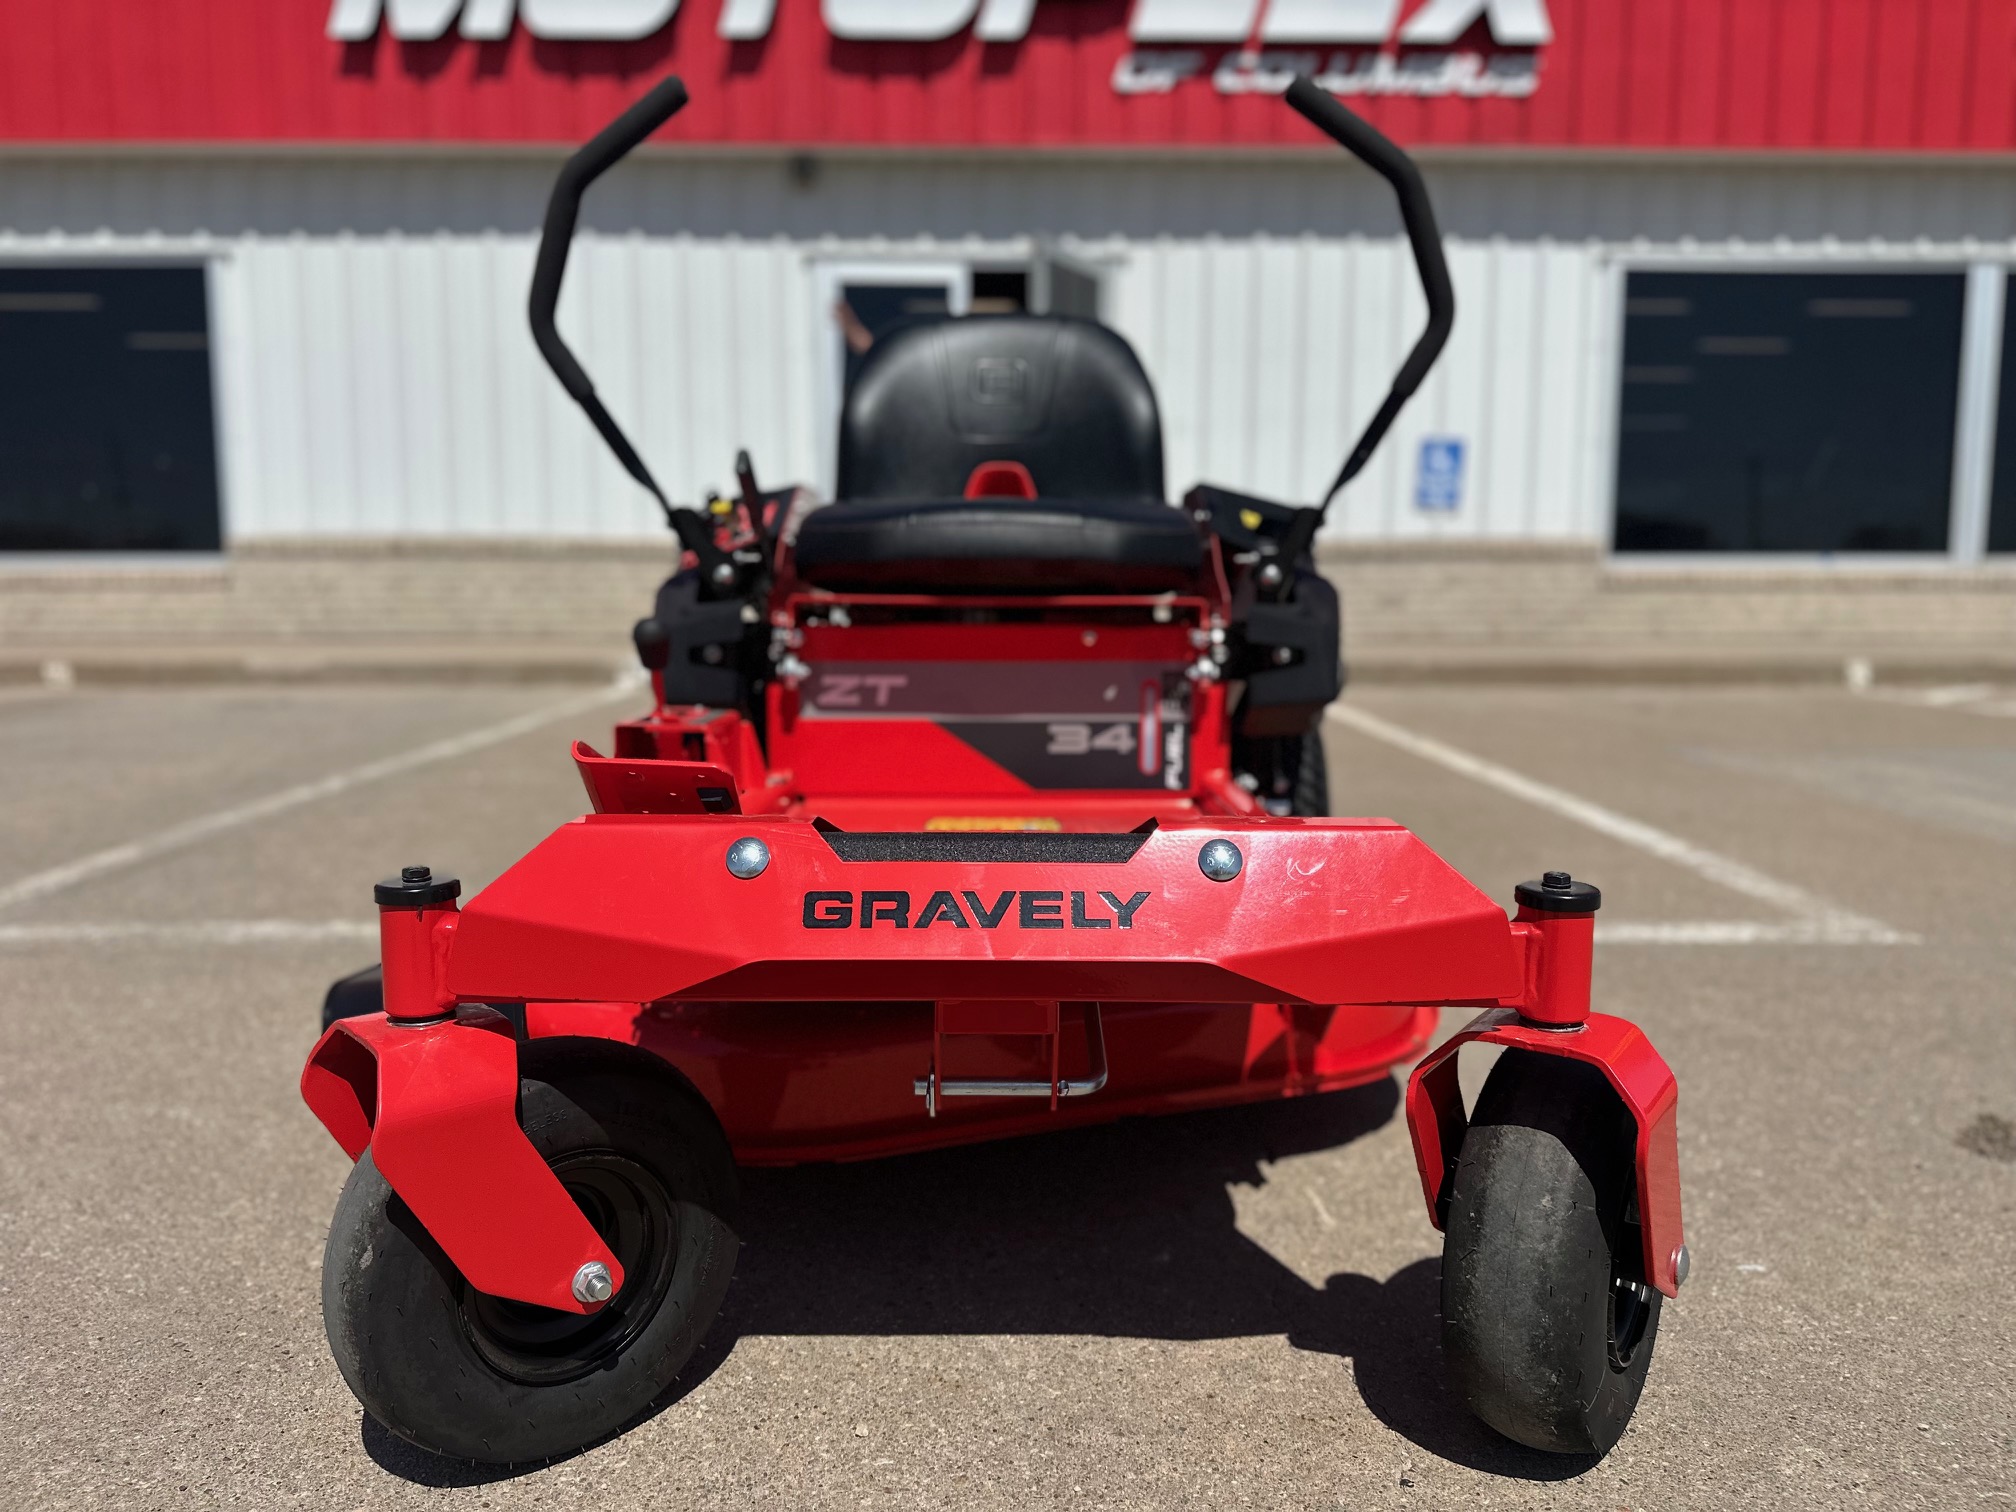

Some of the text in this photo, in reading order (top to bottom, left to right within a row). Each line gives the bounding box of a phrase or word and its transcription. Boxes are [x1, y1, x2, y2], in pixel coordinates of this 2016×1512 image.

[815, 674, 907, 707] ZT
[1046, 723, 1136, 755] 34
[1163, 722, 1185, 791] FUEL
[802, 890, 1152, 930] GRAVELY
